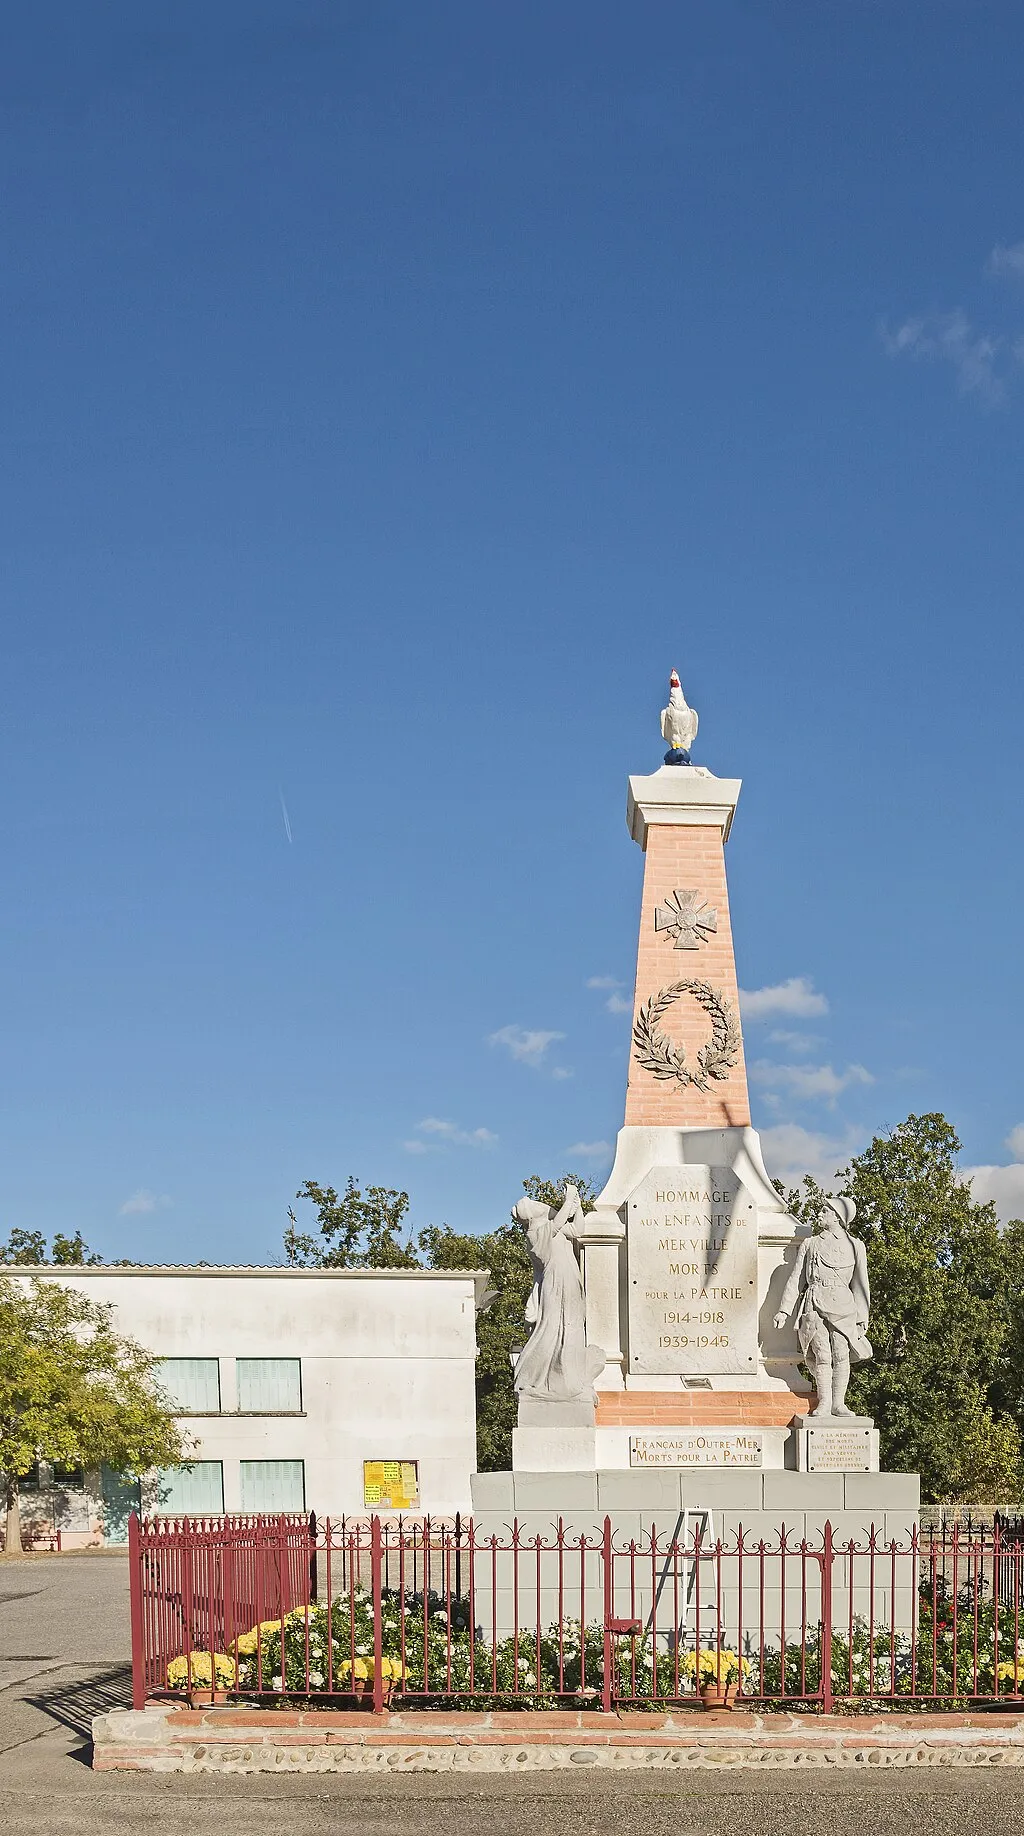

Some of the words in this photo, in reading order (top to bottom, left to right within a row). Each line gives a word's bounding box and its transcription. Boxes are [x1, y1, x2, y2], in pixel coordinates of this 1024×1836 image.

[656, 1191, 730, 1203] HOMMAGE
[641, 1219, 659, 1227] AUX
[664, 1215, 732, 1227] ENFANTS
[736, 1219, 747, 1227] DE
[658, 1239, 728, 1251] MERVILLE
[669, 1263, 718, 1275] MORTS
[645, 1291, 668, 1300] POUR
[674, 1291, 685, 1299] LA
[691, 1287, 742, 1299] PATRIE
[664, 1311, 725, 1324] 1914-1918
[659, 1335, 729, 1348] 1939-1945
